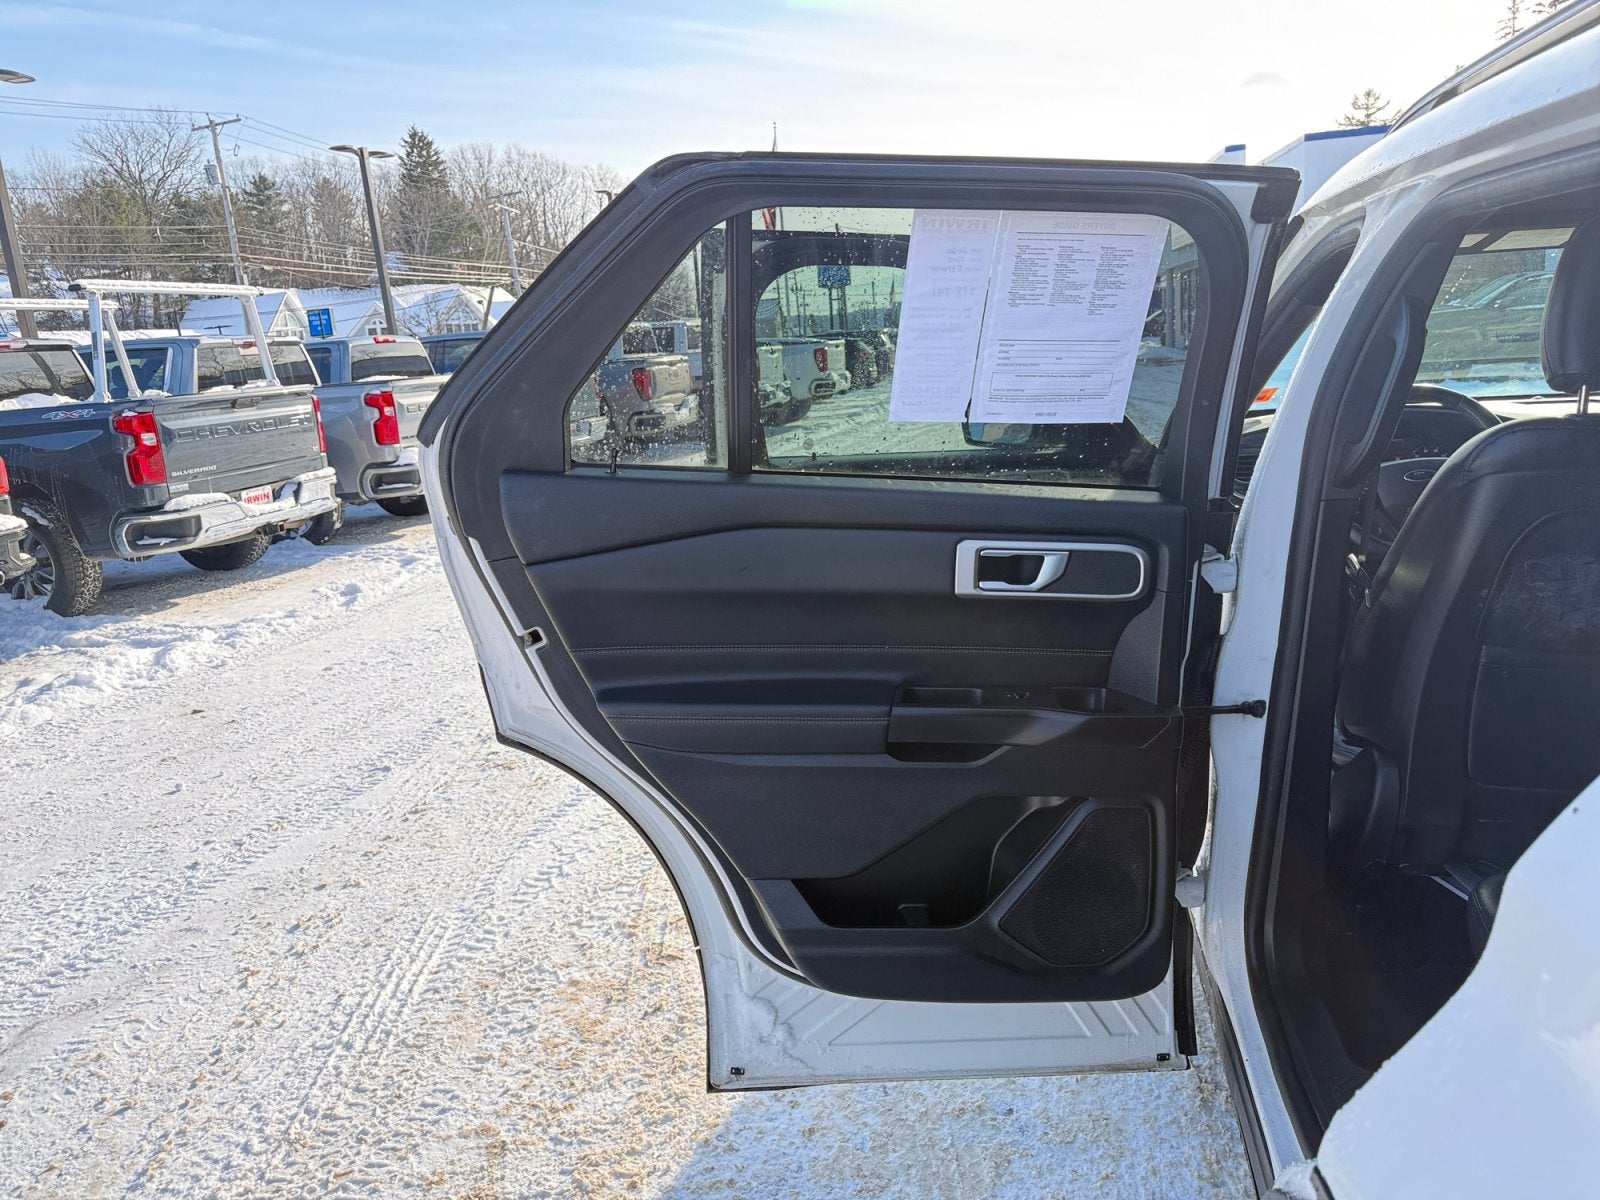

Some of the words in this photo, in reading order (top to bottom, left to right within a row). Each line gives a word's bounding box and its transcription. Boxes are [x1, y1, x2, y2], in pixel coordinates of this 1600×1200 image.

[176, 414, 312, 443] CHEVROLET
[171, 464, 217, 477] SILVERADO
[243, 491, 270, 504] IRWIN
